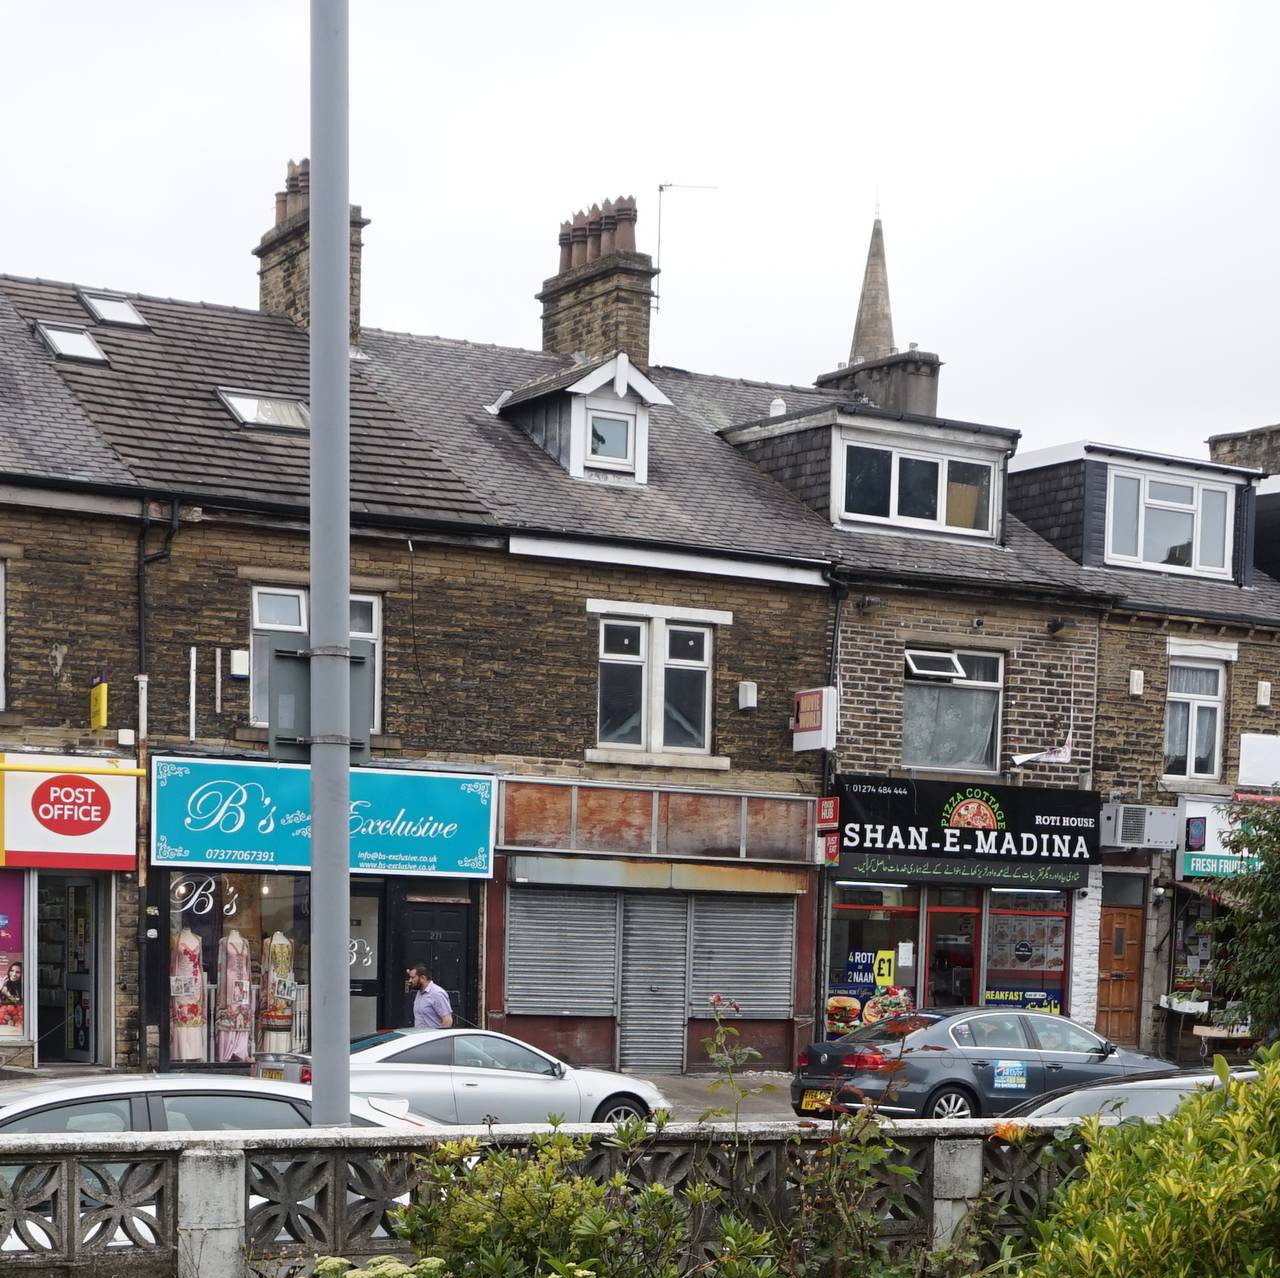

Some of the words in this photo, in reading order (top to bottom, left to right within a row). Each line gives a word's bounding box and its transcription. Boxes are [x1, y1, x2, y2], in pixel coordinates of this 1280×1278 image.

[50, 787, 96, 804] POST
[852, 784, 876, 793] 01274
[878, 786, 892, 794] 484
[894, 787, 908, 795] 444
[38, 803, 102, 822] OFFICE
[184, 780, 276, 834] B's
[822, 809, 834, 819] HUB
[941, 792, 964, 828] PIZZA
[965, 788, 1006, 830] COTTAGE
[1035, 815, 1061, 826] ROTI
[1062, 817, 1096, 828] HOUSE
[827, 836, 838, 846] JUST
[843, 823, 1090, 858] SHAN-E-MADINA
[205, 849, 275, 862] 07377067391
[1191, 858, 1217, 872] FRESH
[169, 873, 238, 915] B's
[848, 952, 854, 962] 4
[854, 952, 874, 964] ROTI
[877, 958, 891, 977] £1
[848, 972, 853, 982] 2
[853, 972, 874, 983] NAAN
